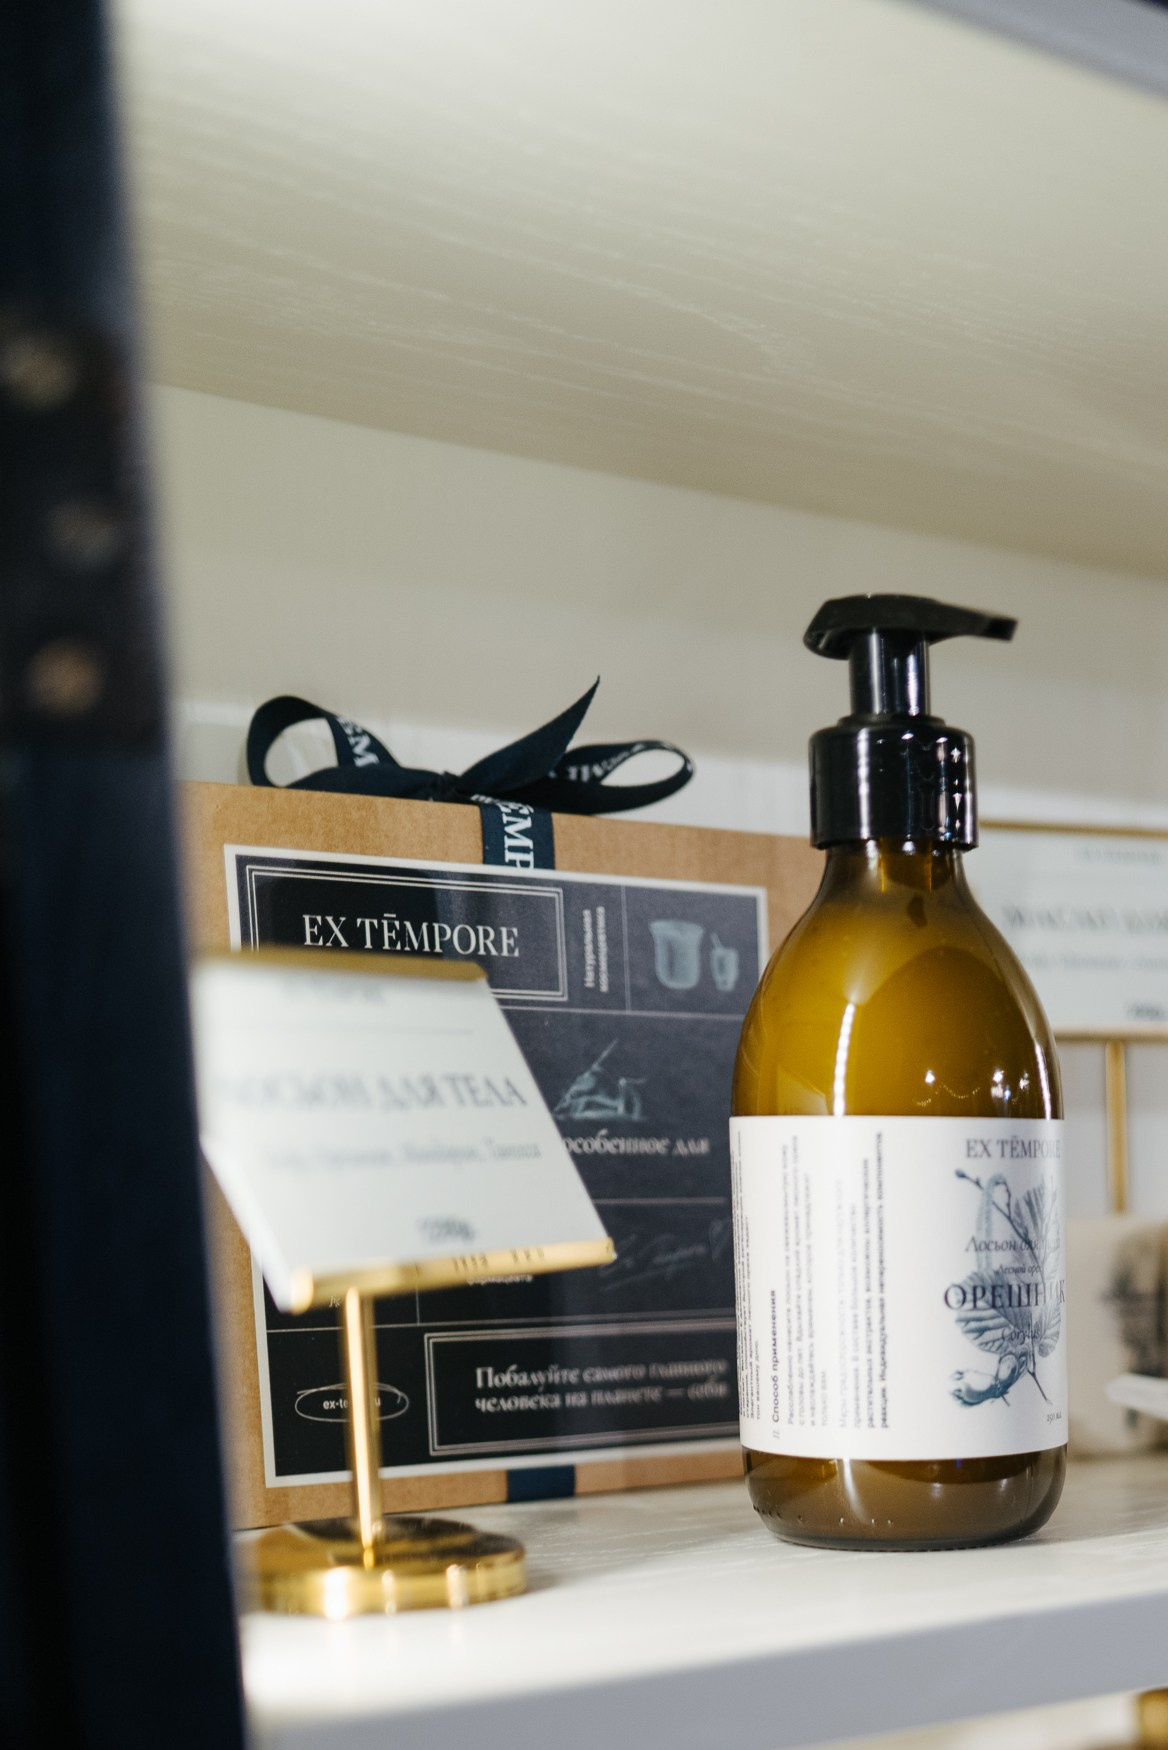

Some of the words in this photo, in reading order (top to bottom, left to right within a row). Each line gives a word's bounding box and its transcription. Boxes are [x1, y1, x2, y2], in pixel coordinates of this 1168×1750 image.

[303, 914, 351, 948] EX
[357, 913, 519, 957] TĒMPORE
[965, 1138, 992, 1158] EX
[965, 1235, 1016, 1252] Лосьон
[771, 1290, 780, 1372] применения
[475, 1364, 579, 1392] Побалуйте
[582, 1367, 646, 1385] самого
[475, 1390, 560, 1412] человека
[565, 1392, 587, 1408] на
[591, 1386, 663, 1406] планете
[771, 1375, 780, 1423] Способ
